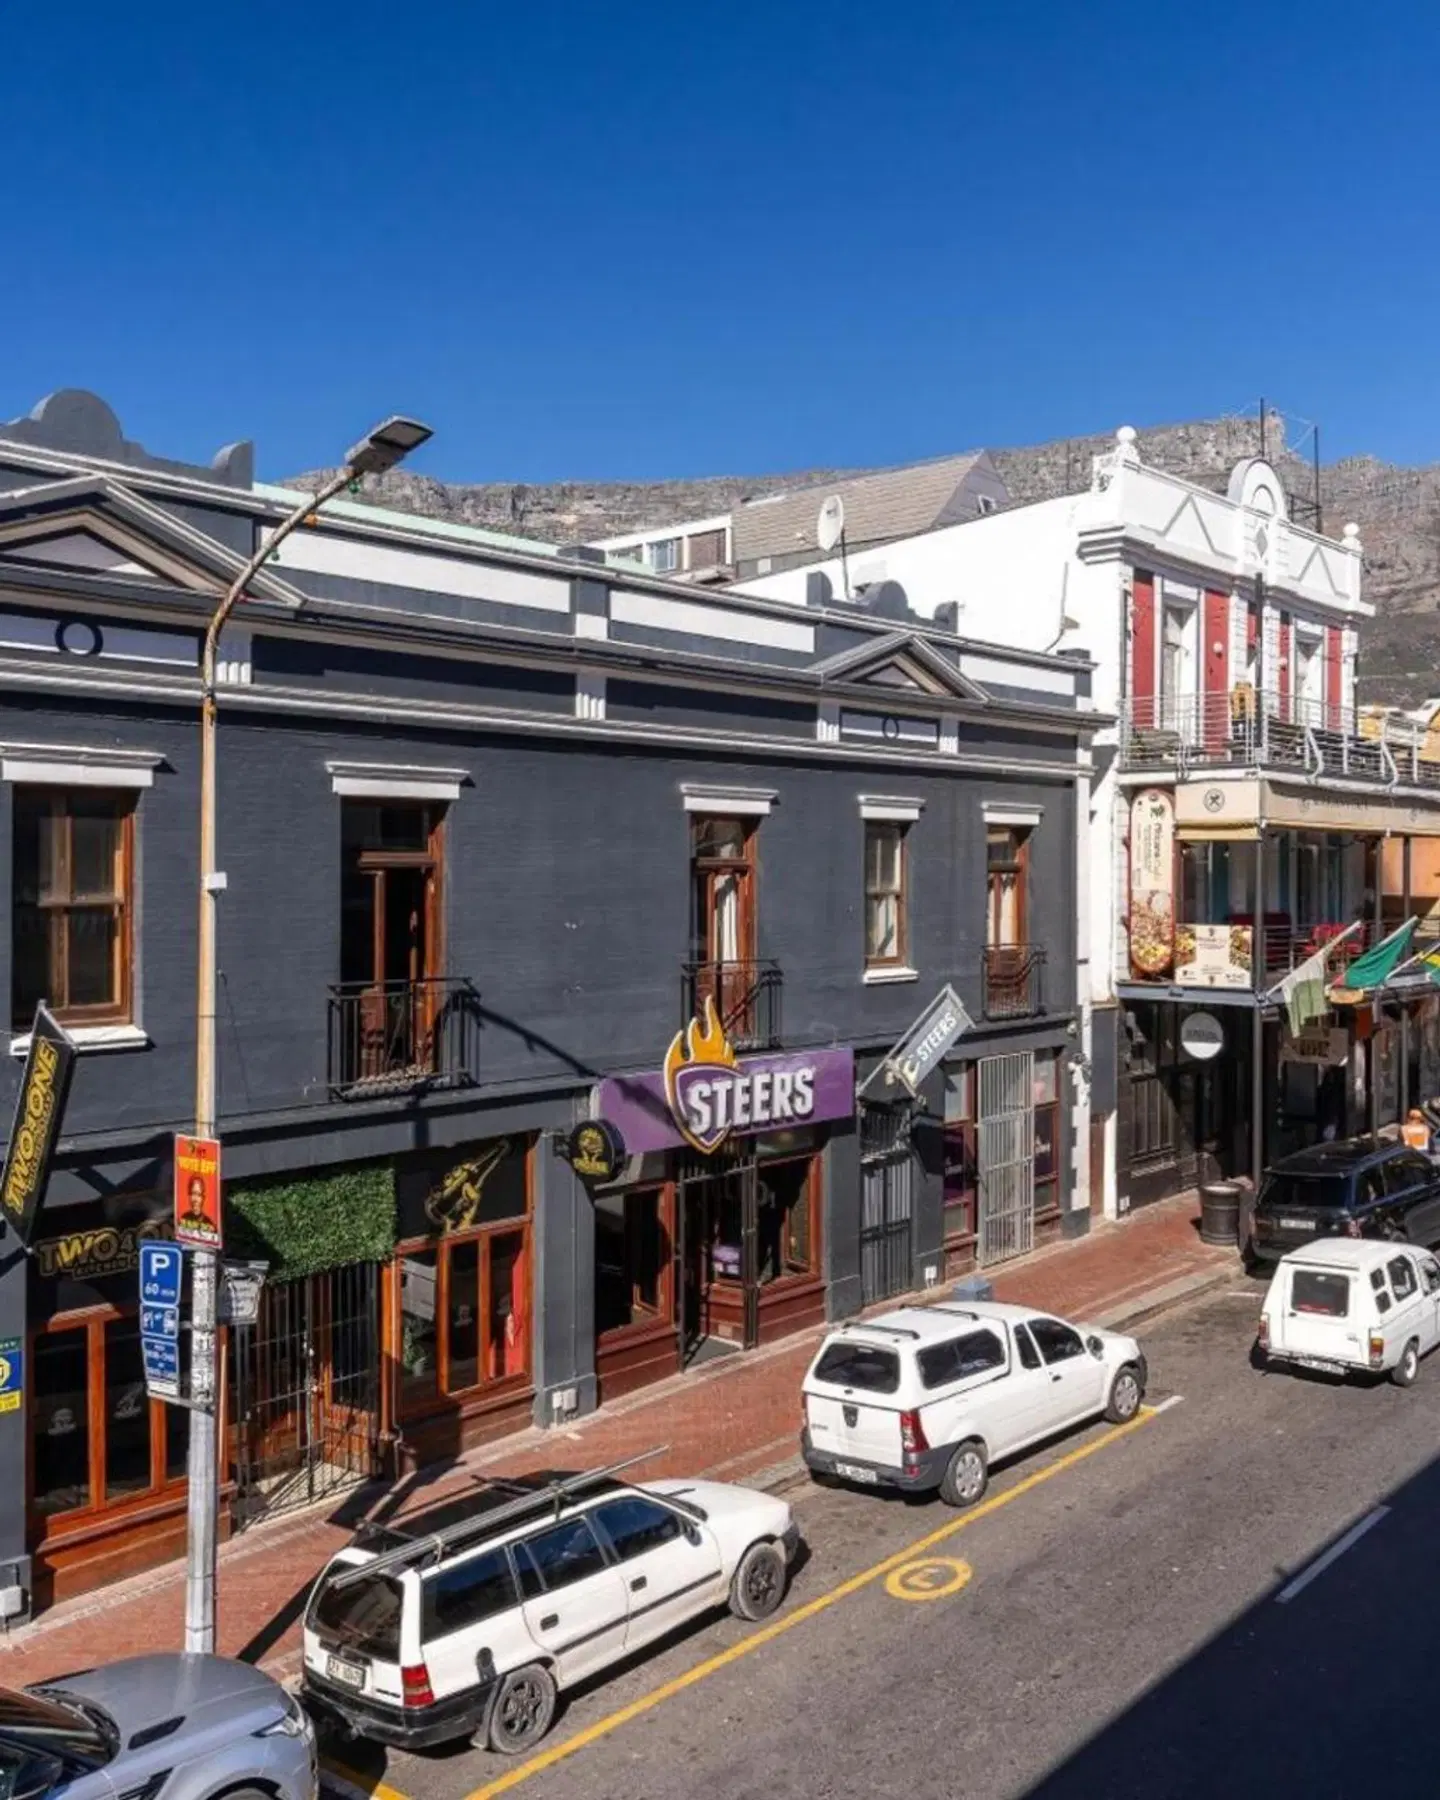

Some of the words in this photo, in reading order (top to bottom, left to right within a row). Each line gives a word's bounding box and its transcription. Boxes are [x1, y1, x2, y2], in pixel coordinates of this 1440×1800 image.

[917, 1012, 958, 1062] STEERS
[687, 1067, 815, 1136] STEERS
[151, 1252, 171, 1277] P
